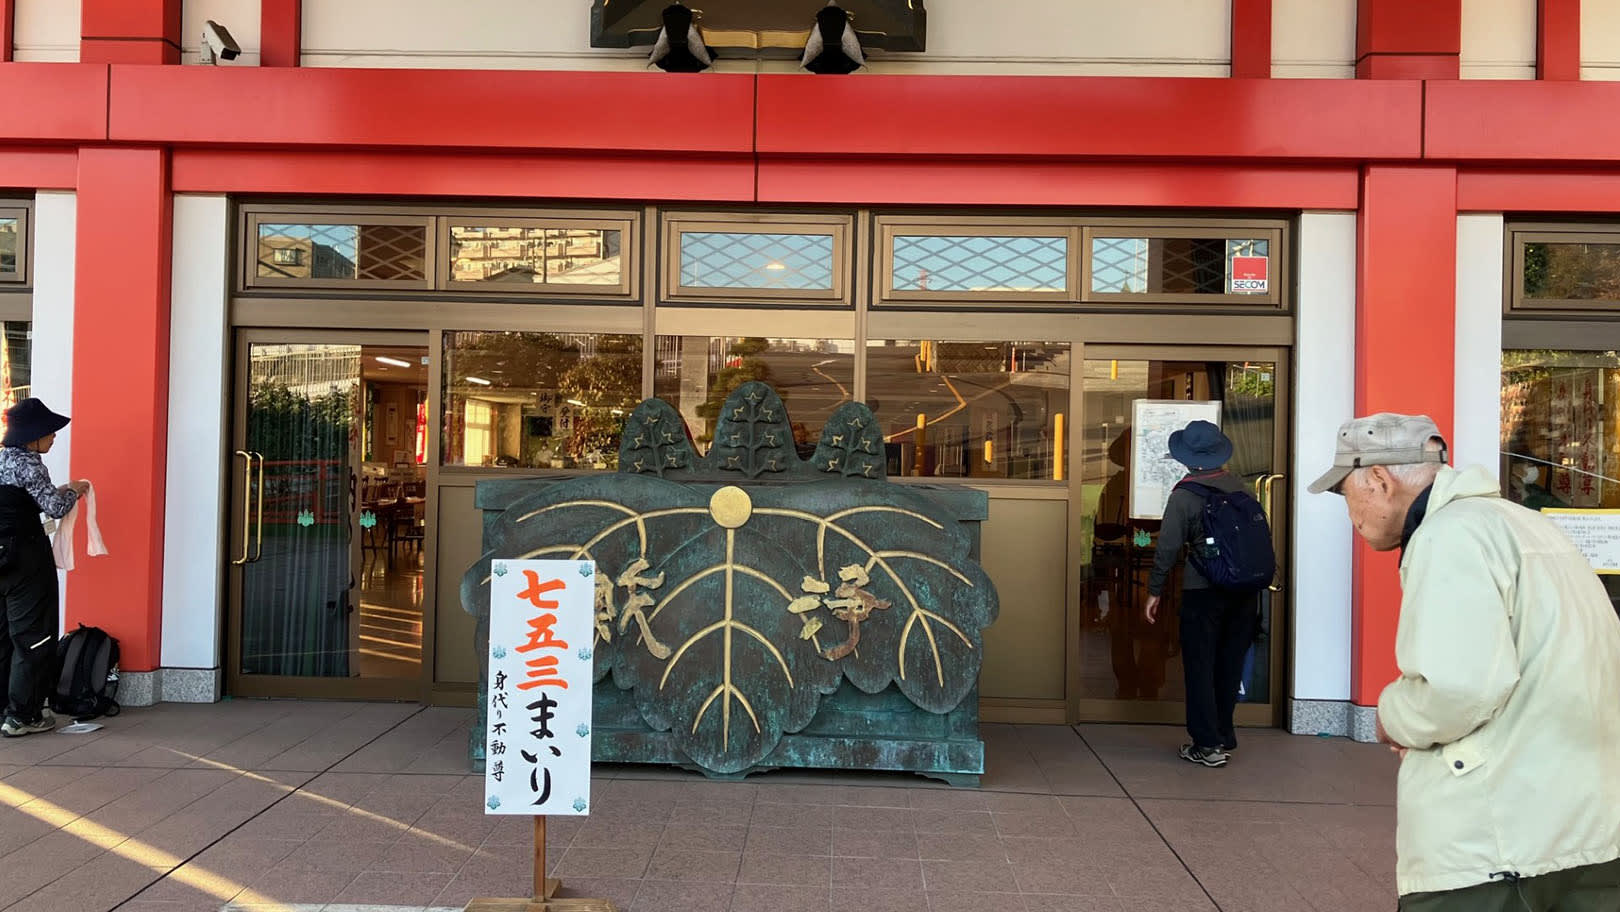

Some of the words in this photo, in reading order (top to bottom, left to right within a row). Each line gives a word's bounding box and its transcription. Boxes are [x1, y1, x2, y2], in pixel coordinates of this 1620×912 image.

[1234, 281, 1265, 289] SECOM
[490, 670, 509, 783] 身代り不動尊
[514, 569, 569, 806] 七五三まいり
